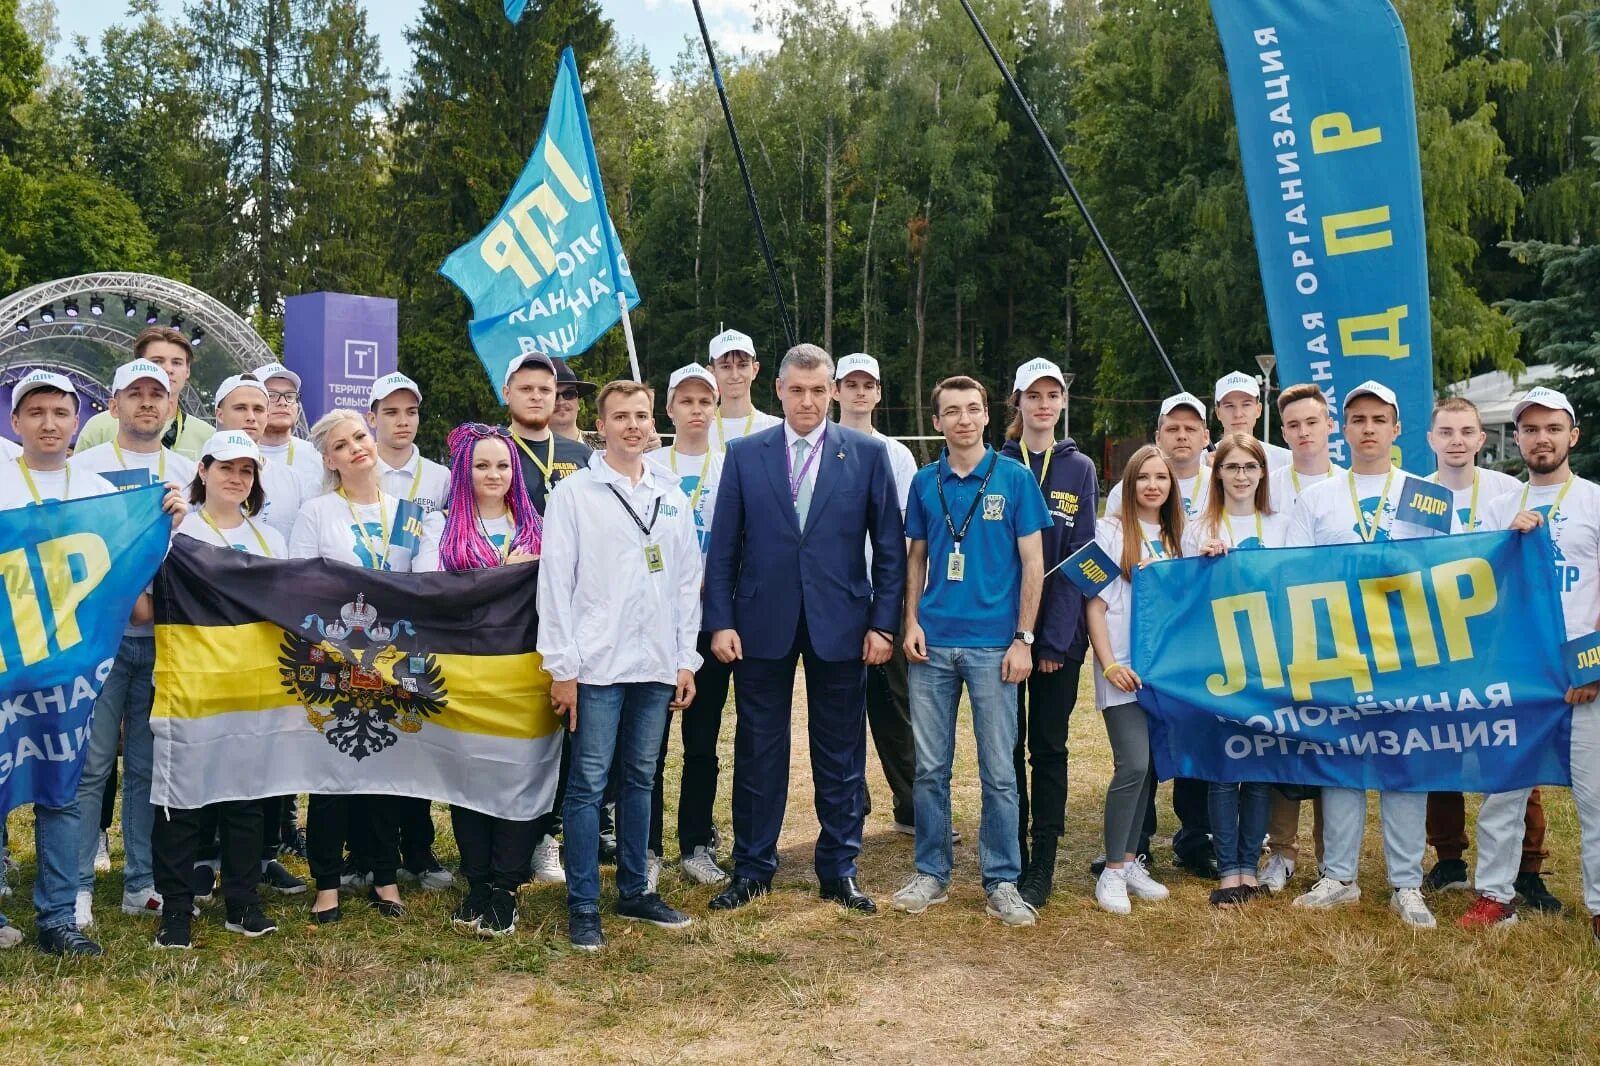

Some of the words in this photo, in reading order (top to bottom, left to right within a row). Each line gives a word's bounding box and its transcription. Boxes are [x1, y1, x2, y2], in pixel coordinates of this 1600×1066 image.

[1253, 27, 1319, 295] ОРГАНИЗАЦИЯ
[131, 364, 158, 373] ЛДПР
[1029, 362, 1053, 371] ЛДПР
[1409, 493, 1448, 517] ЛДПР
[1078, 558, 1108, 584] ЛДПР
[1205, 557, 1499, 701] ЛДПР
[1225, 718, 1518, 760] ОРГАНИЗАЦИЯ
